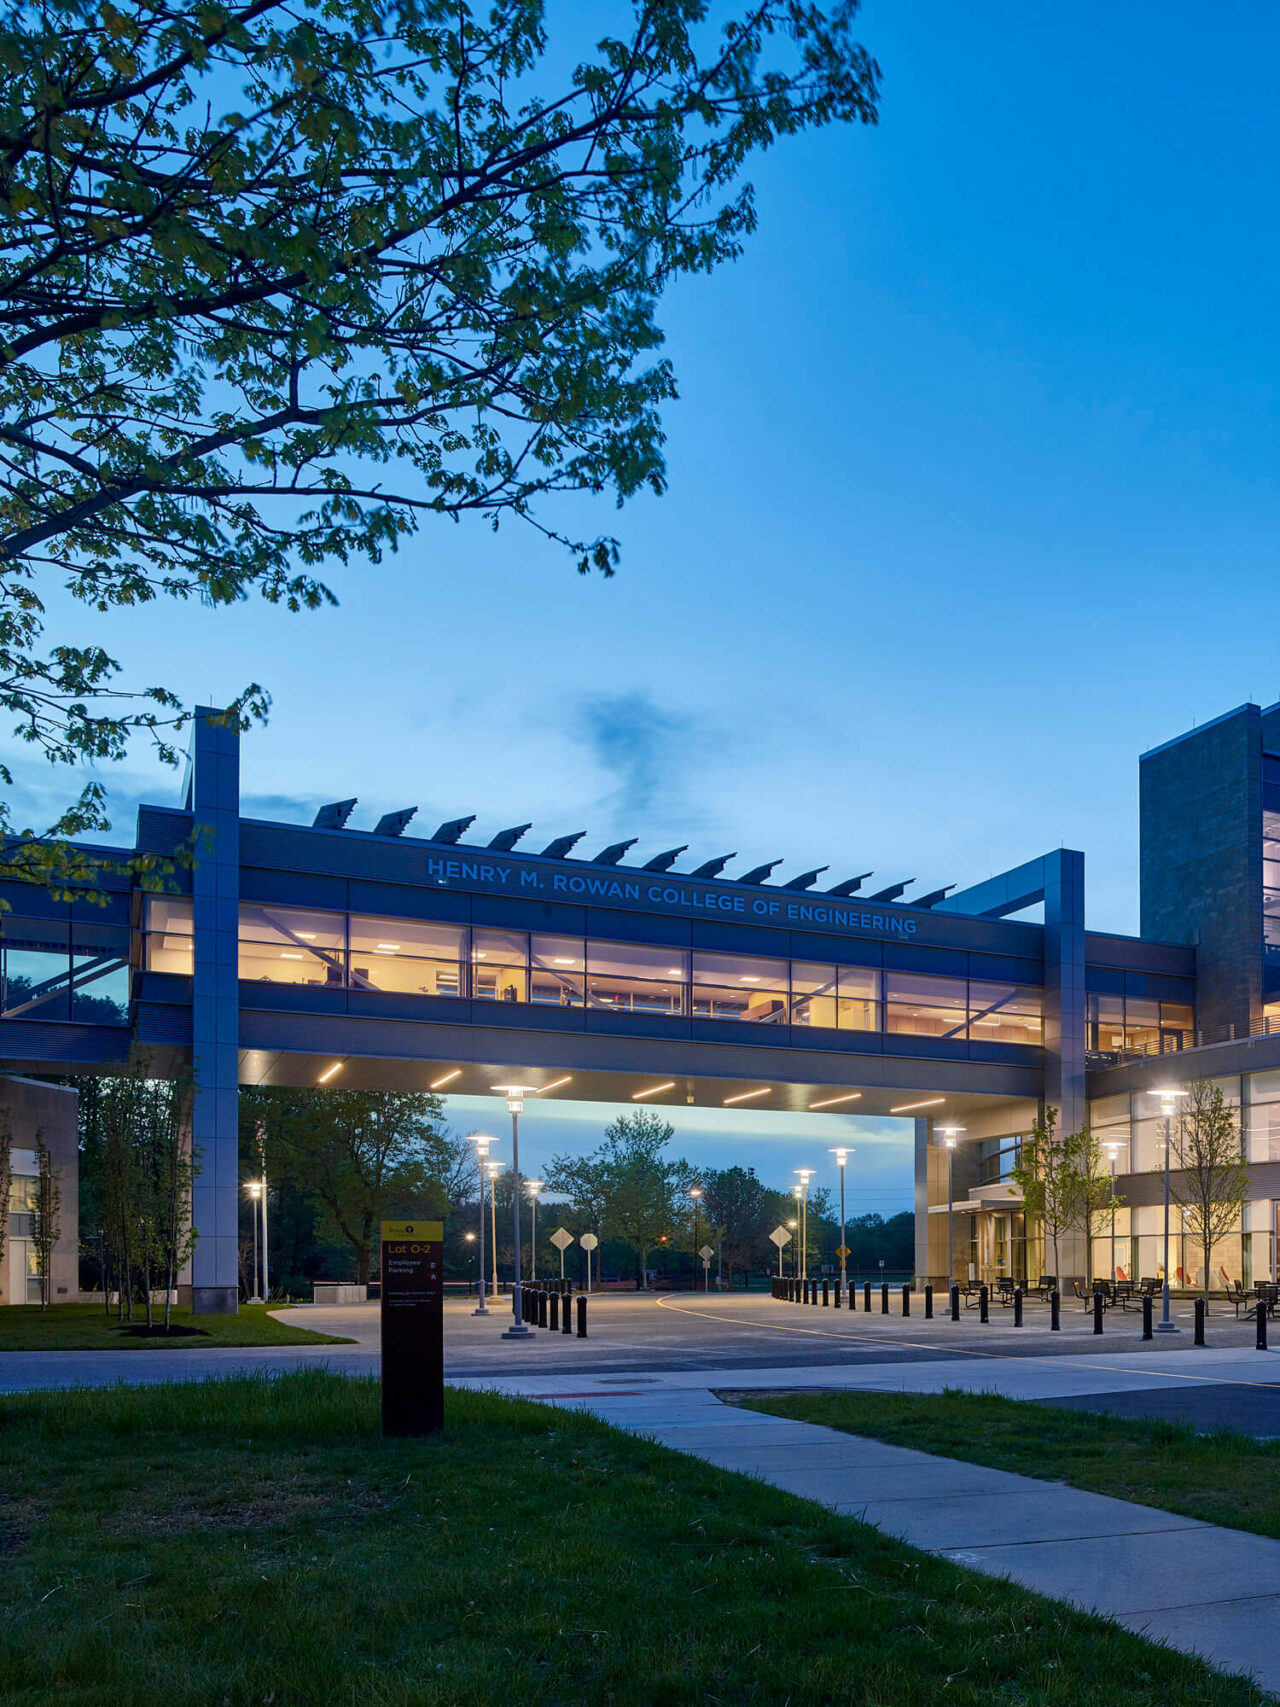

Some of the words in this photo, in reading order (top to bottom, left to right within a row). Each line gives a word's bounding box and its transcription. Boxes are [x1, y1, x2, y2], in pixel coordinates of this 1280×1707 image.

[427, 858, 511, 883] HENRY
[519, 870, 544, 888] M.
[553, 875, 640, 899] ROWAN
[648, 886, 745, 912] COLLEGE
[752, 900, 780, 917] OF
[787, 904, 917, 933] ENGINEERING
[388, 1244, 406, 1254] Lot
[410, 1244, 431, 1254] O-2
